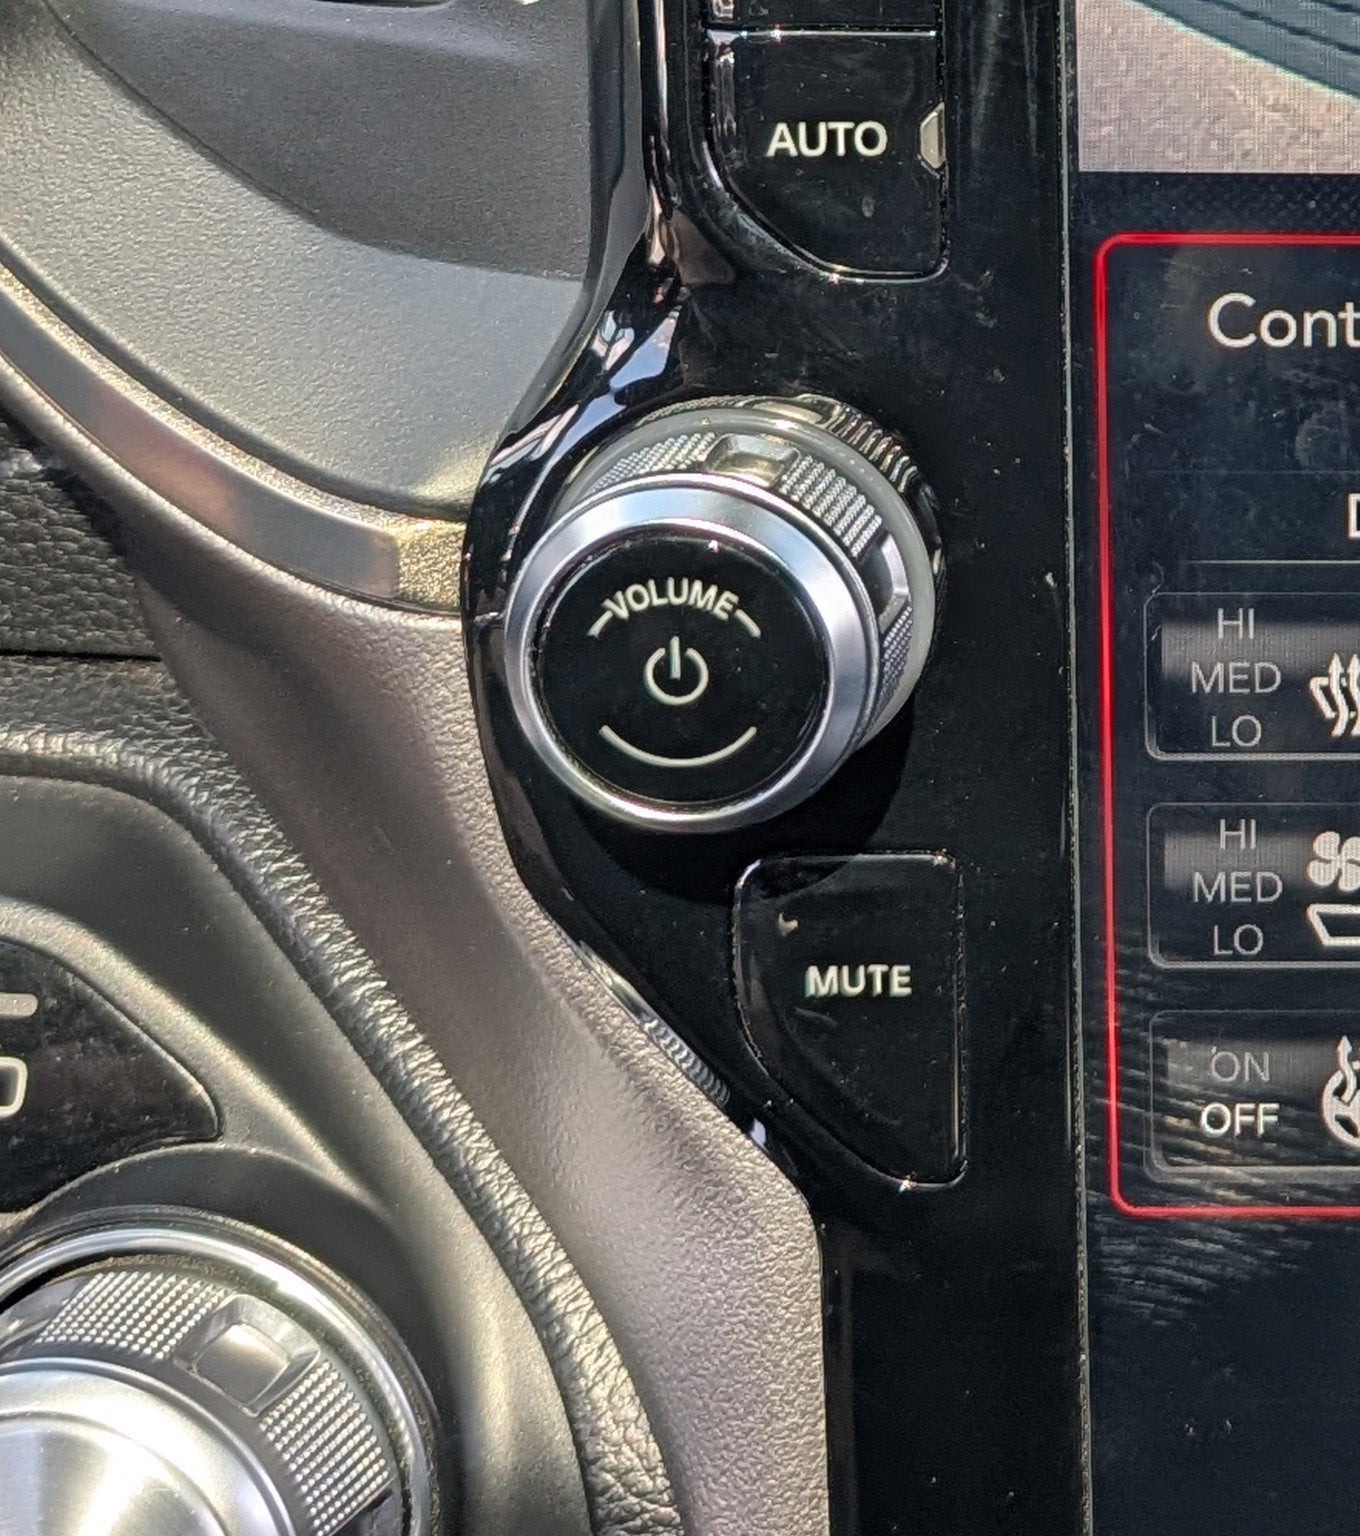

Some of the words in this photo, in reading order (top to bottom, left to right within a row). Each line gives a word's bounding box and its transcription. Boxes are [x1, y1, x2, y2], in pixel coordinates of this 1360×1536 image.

[766, 120, 888, 157] AUTO
[602, 577, 740, 621] VOLUME
[1216, 608, 1256, 640] HI
[1190, 662, 1282, 694] MED
[1210, 716, 1262, 748] LO
[1219, 819, 1258, 851] HI
[1193, 871, 1284, 904] MED
[1212, 924, 1264, 957] LO
[804, 964, 913, 998] MUTE
[1211, 1050, 1271, 1082] ON
[1200, 1102, 1281, 1136] OFF
